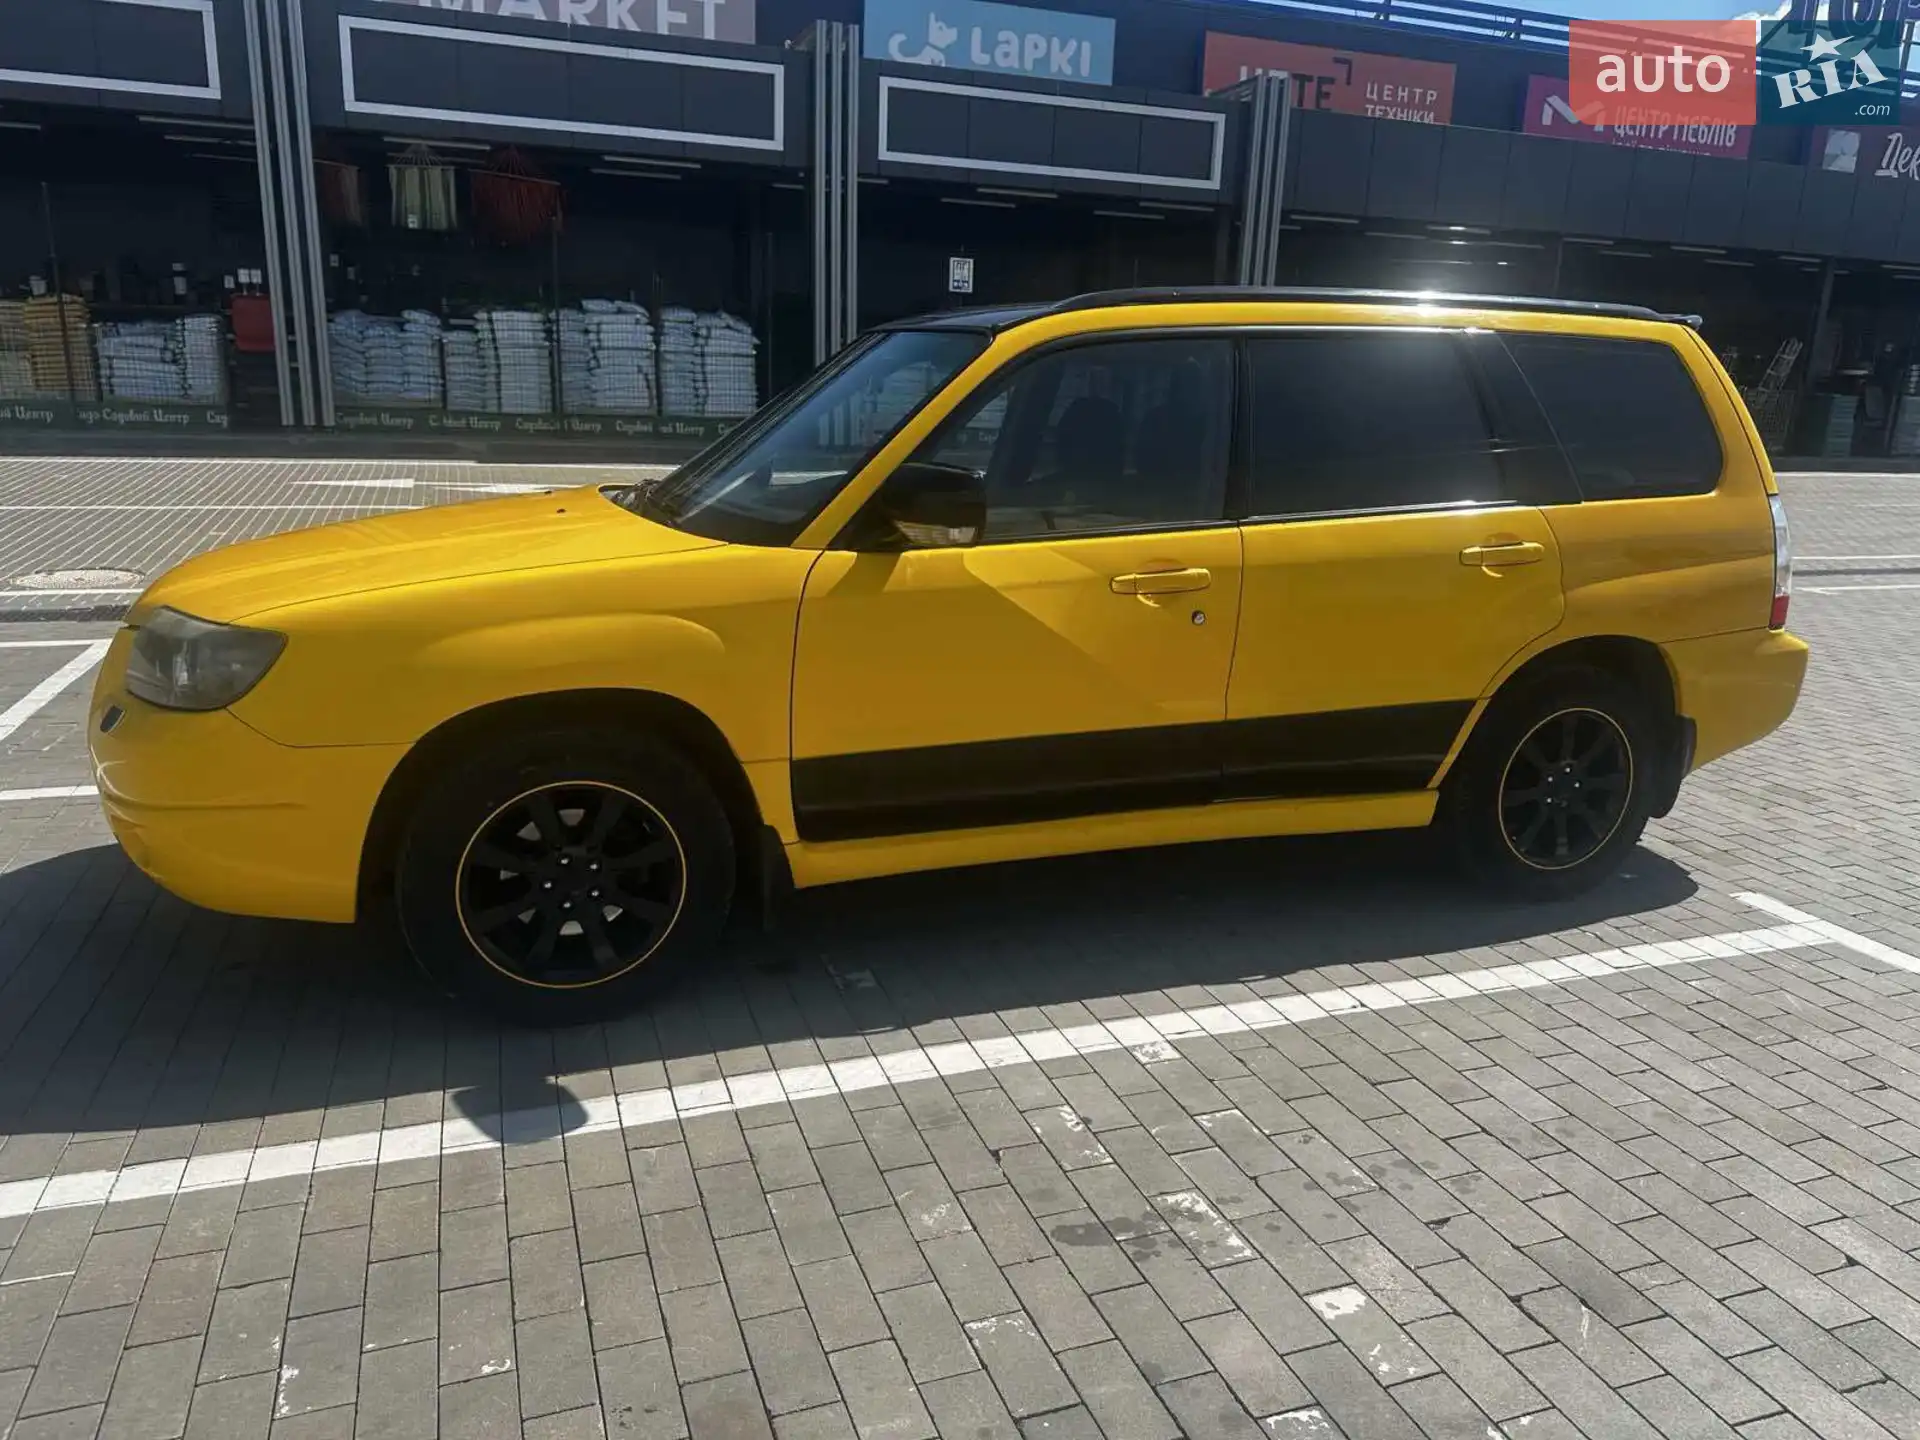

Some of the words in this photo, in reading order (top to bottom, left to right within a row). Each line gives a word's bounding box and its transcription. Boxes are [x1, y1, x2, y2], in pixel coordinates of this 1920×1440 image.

[1366, 82, 1437, 105] ЦЕНТР
[1365, 104, 1435, 124] ТЕХНІКИ
[1613, 105, 1672, 140] ЦЕНТР
[1673, 113, 1738, 148] МЕБЛІВ
